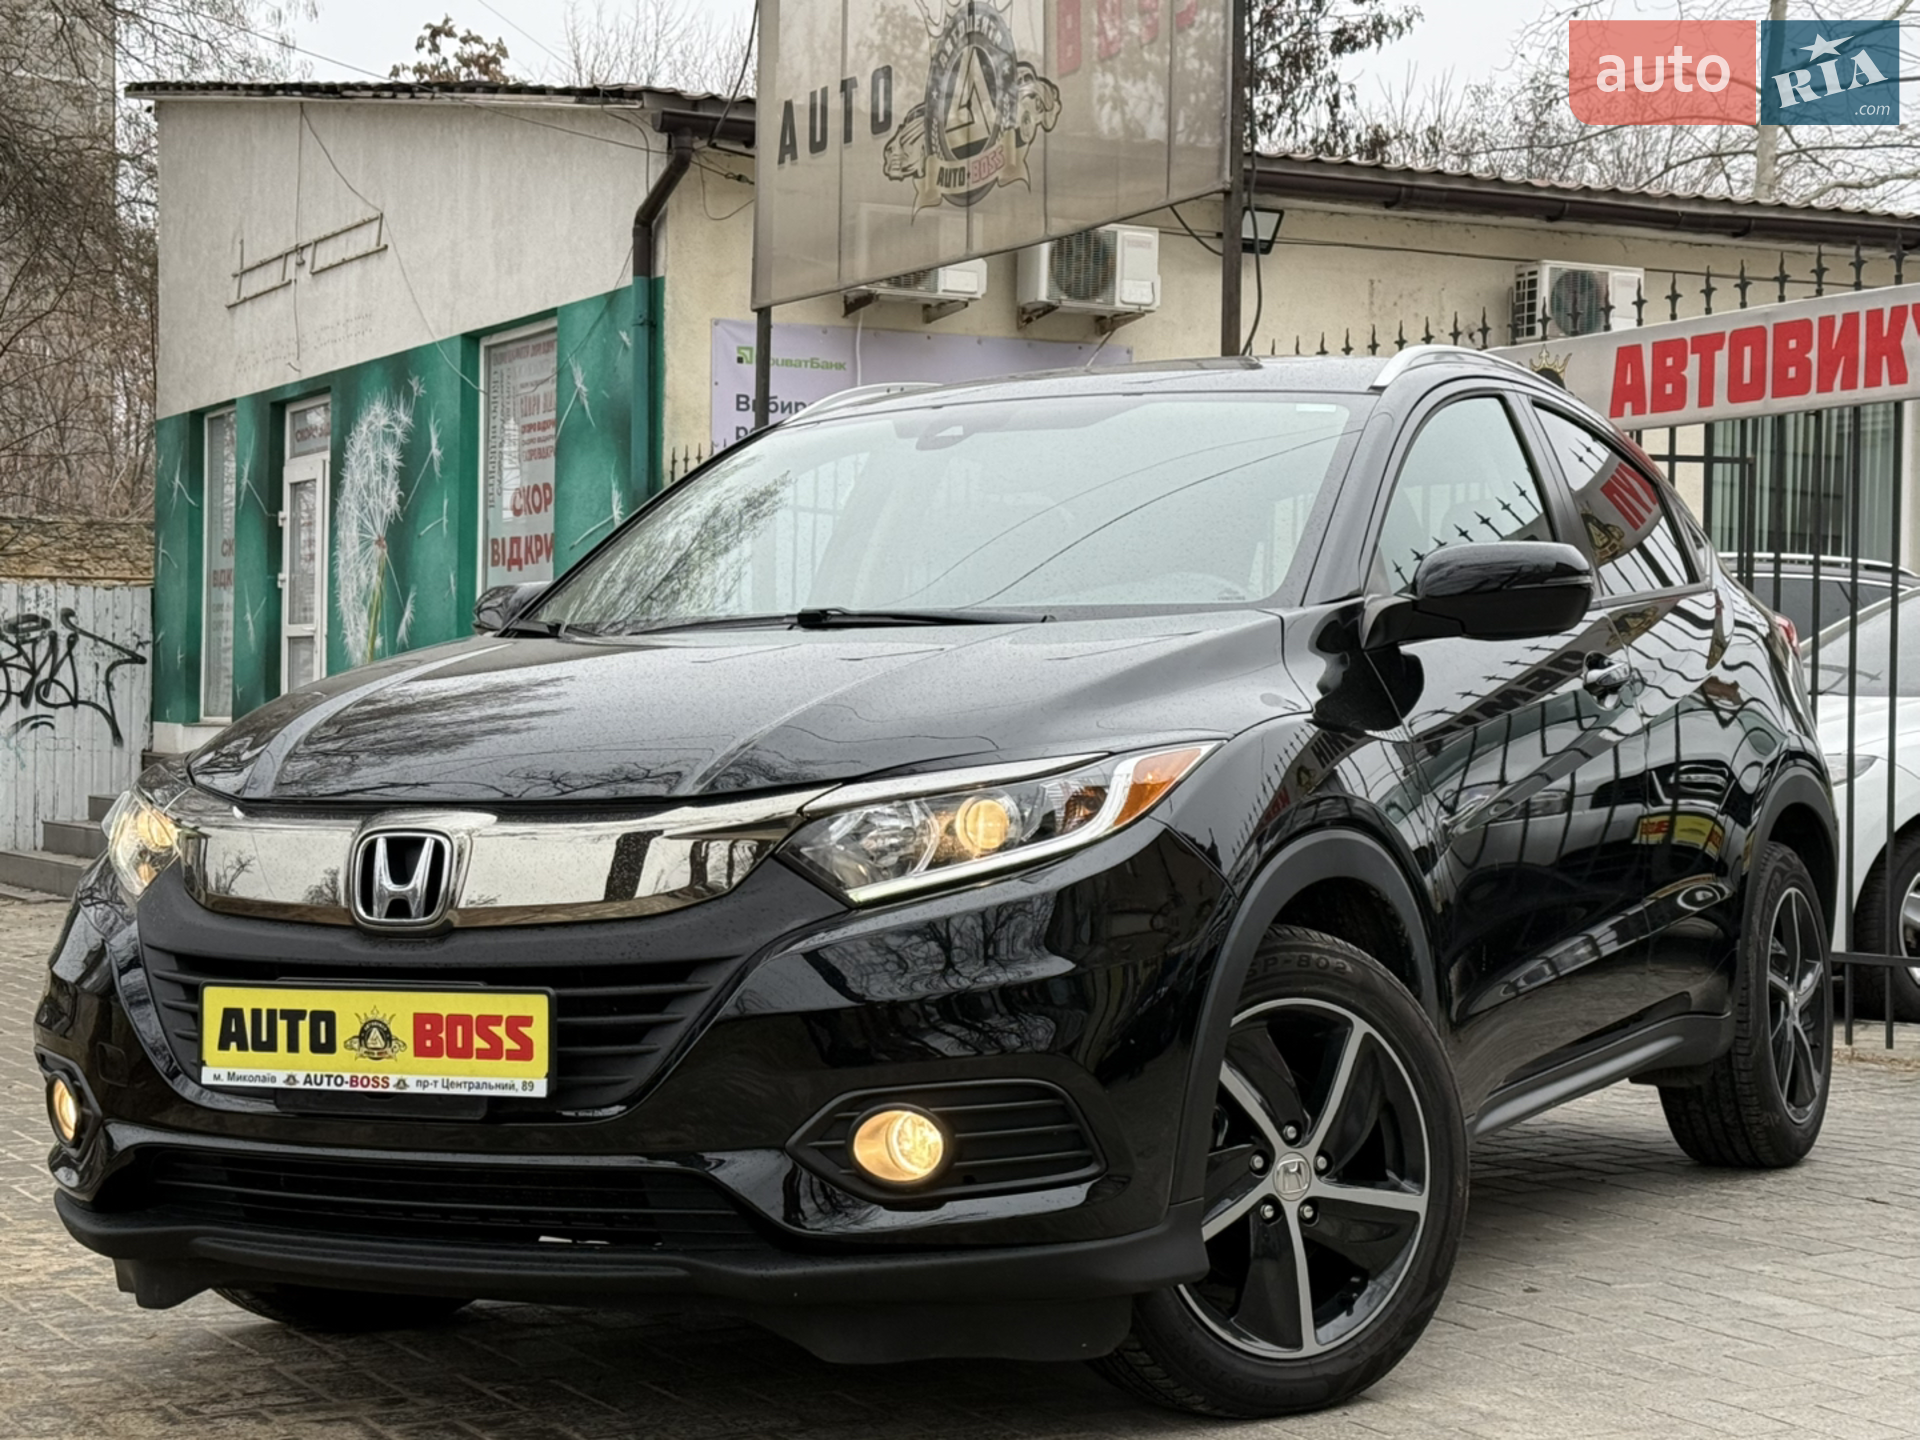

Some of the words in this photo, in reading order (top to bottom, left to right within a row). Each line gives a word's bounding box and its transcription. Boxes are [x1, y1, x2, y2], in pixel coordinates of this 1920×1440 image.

[777, 65, 893, 166] AUTO
[512, 482, 553, 517] СКОР
[218, 1007, 337, 1054] AUTO
[413, 1012, 534, 1061] BOSS
[213, 1072, 224, 1083] м.
[227, 1071, 277, 1084] Миколаїв
[303, 1073, 390, 1089] AUTO-BOSS
[416, 1079, 438, 1091] пр-т
[441, 1078, 518, 1092] Центральний,
[521, 1080, 535, 1092] 89
